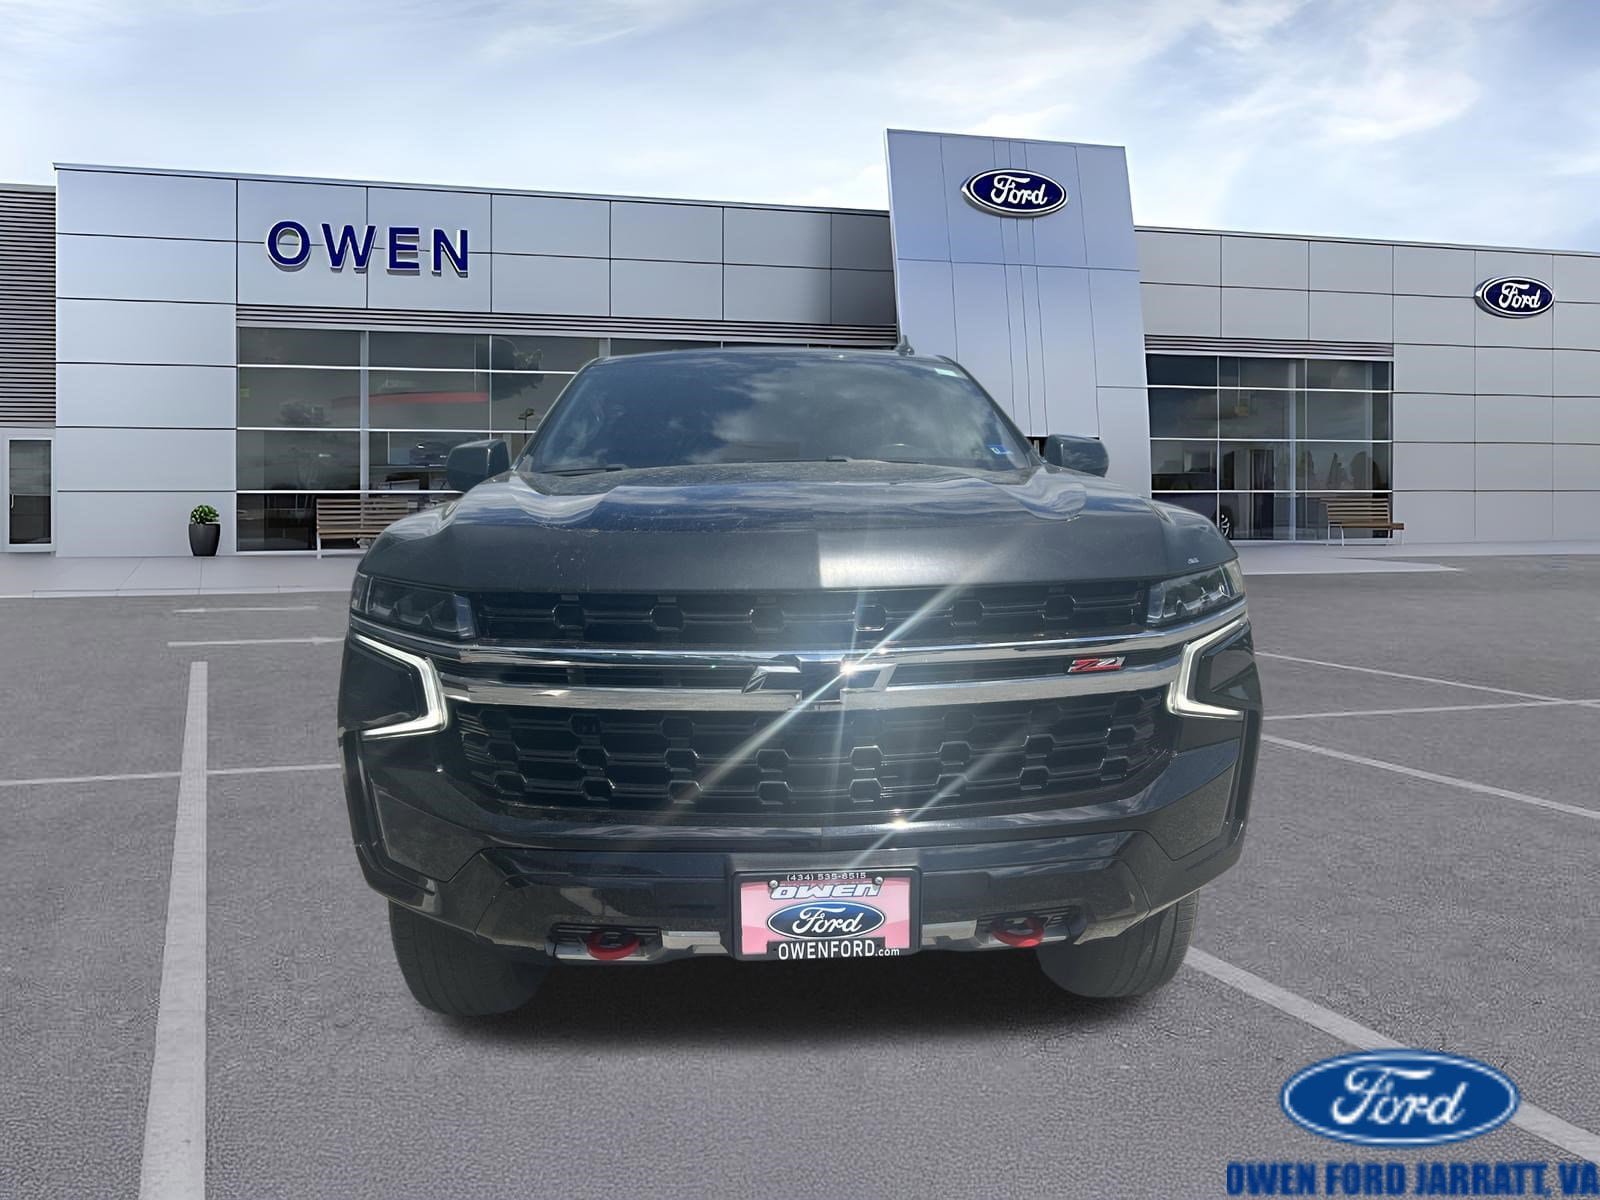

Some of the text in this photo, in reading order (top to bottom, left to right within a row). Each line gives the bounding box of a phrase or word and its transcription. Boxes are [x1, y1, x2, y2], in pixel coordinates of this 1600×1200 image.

[990, 175, 1048, 205] Ford
[266, 220, 470, 272] OWEN
[1498, 282, 1542, 309] Ford
[770, 883, 883, 900] OWEN
[791, 906, 865, 934] Ford
[778, 941, 900, 960] OWENFORD.com
